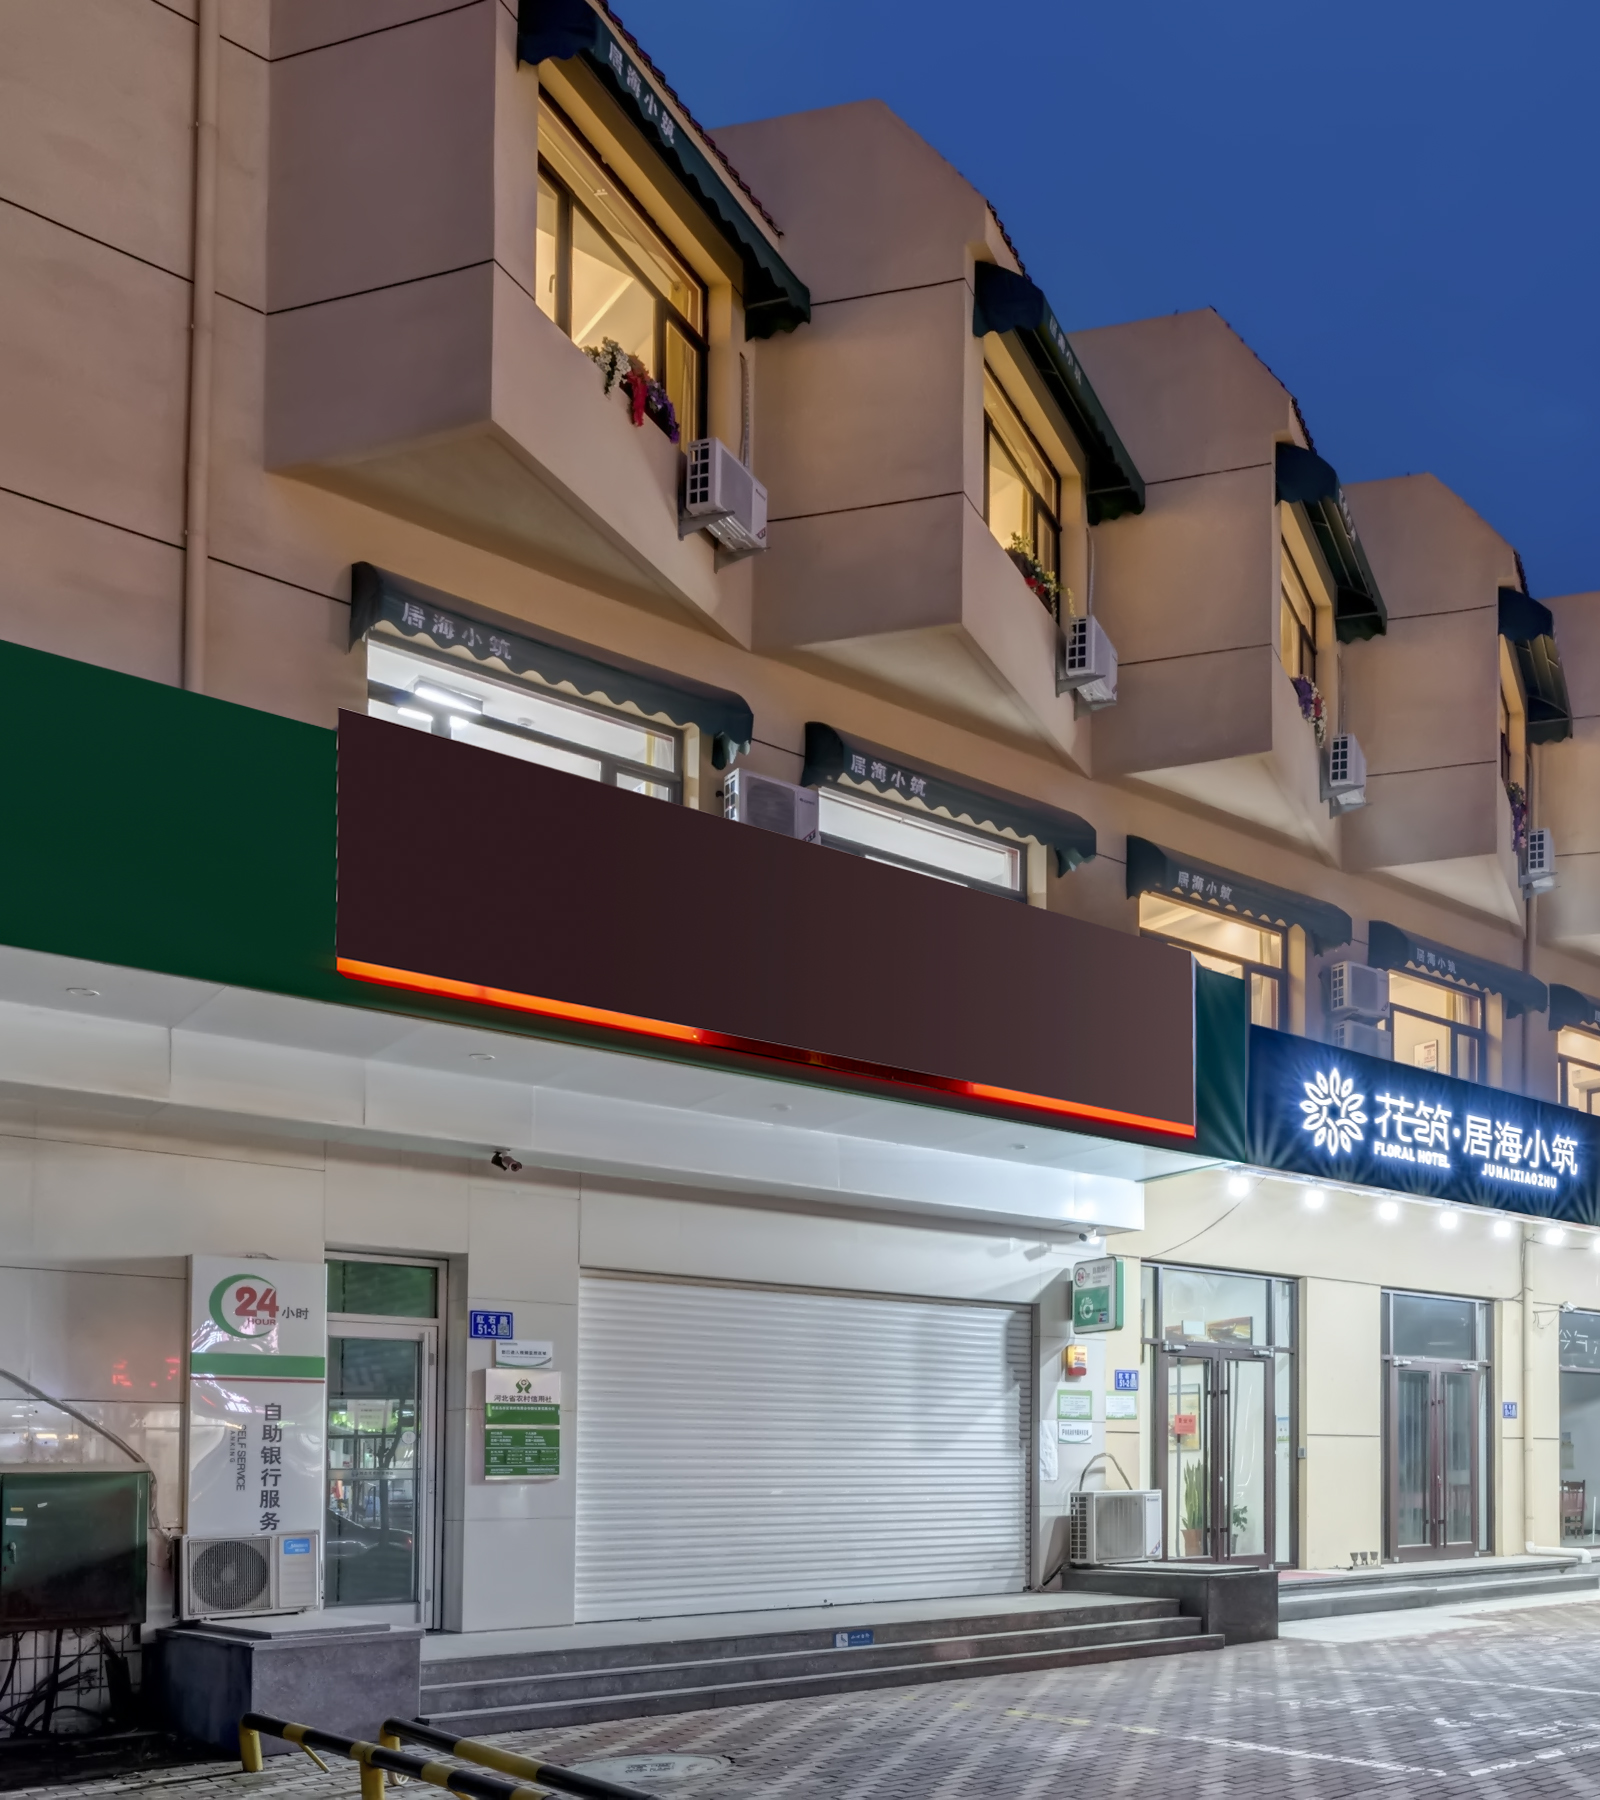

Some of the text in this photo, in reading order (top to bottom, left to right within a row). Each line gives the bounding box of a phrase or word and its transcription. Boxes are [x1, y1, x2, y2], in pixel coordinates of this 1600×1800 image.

[402, 602, 512, 661] 居海小筑
[850, 754, 927, 798] 居海小筑
[1177, 870, 1233, 902] 居海小筑
[1373, 1141, 1451, 1169] FLORAL HOTEL
[1481, 1162, 1558, 1189] JUHAIXIAOZHU
[235, 1285, 279, 1319] 24
[281, 1306, 309, 1320] 小时
[246, 1318, 276, 1326] HOUR
[477, 1324, 497, 1335] 51-3
[493, 1394, 553, 1403] 河北省农村信用社
[236, 1450, 247, 1491] SERVICE
[259, 1402, 282, 1532] 自助银行服务
